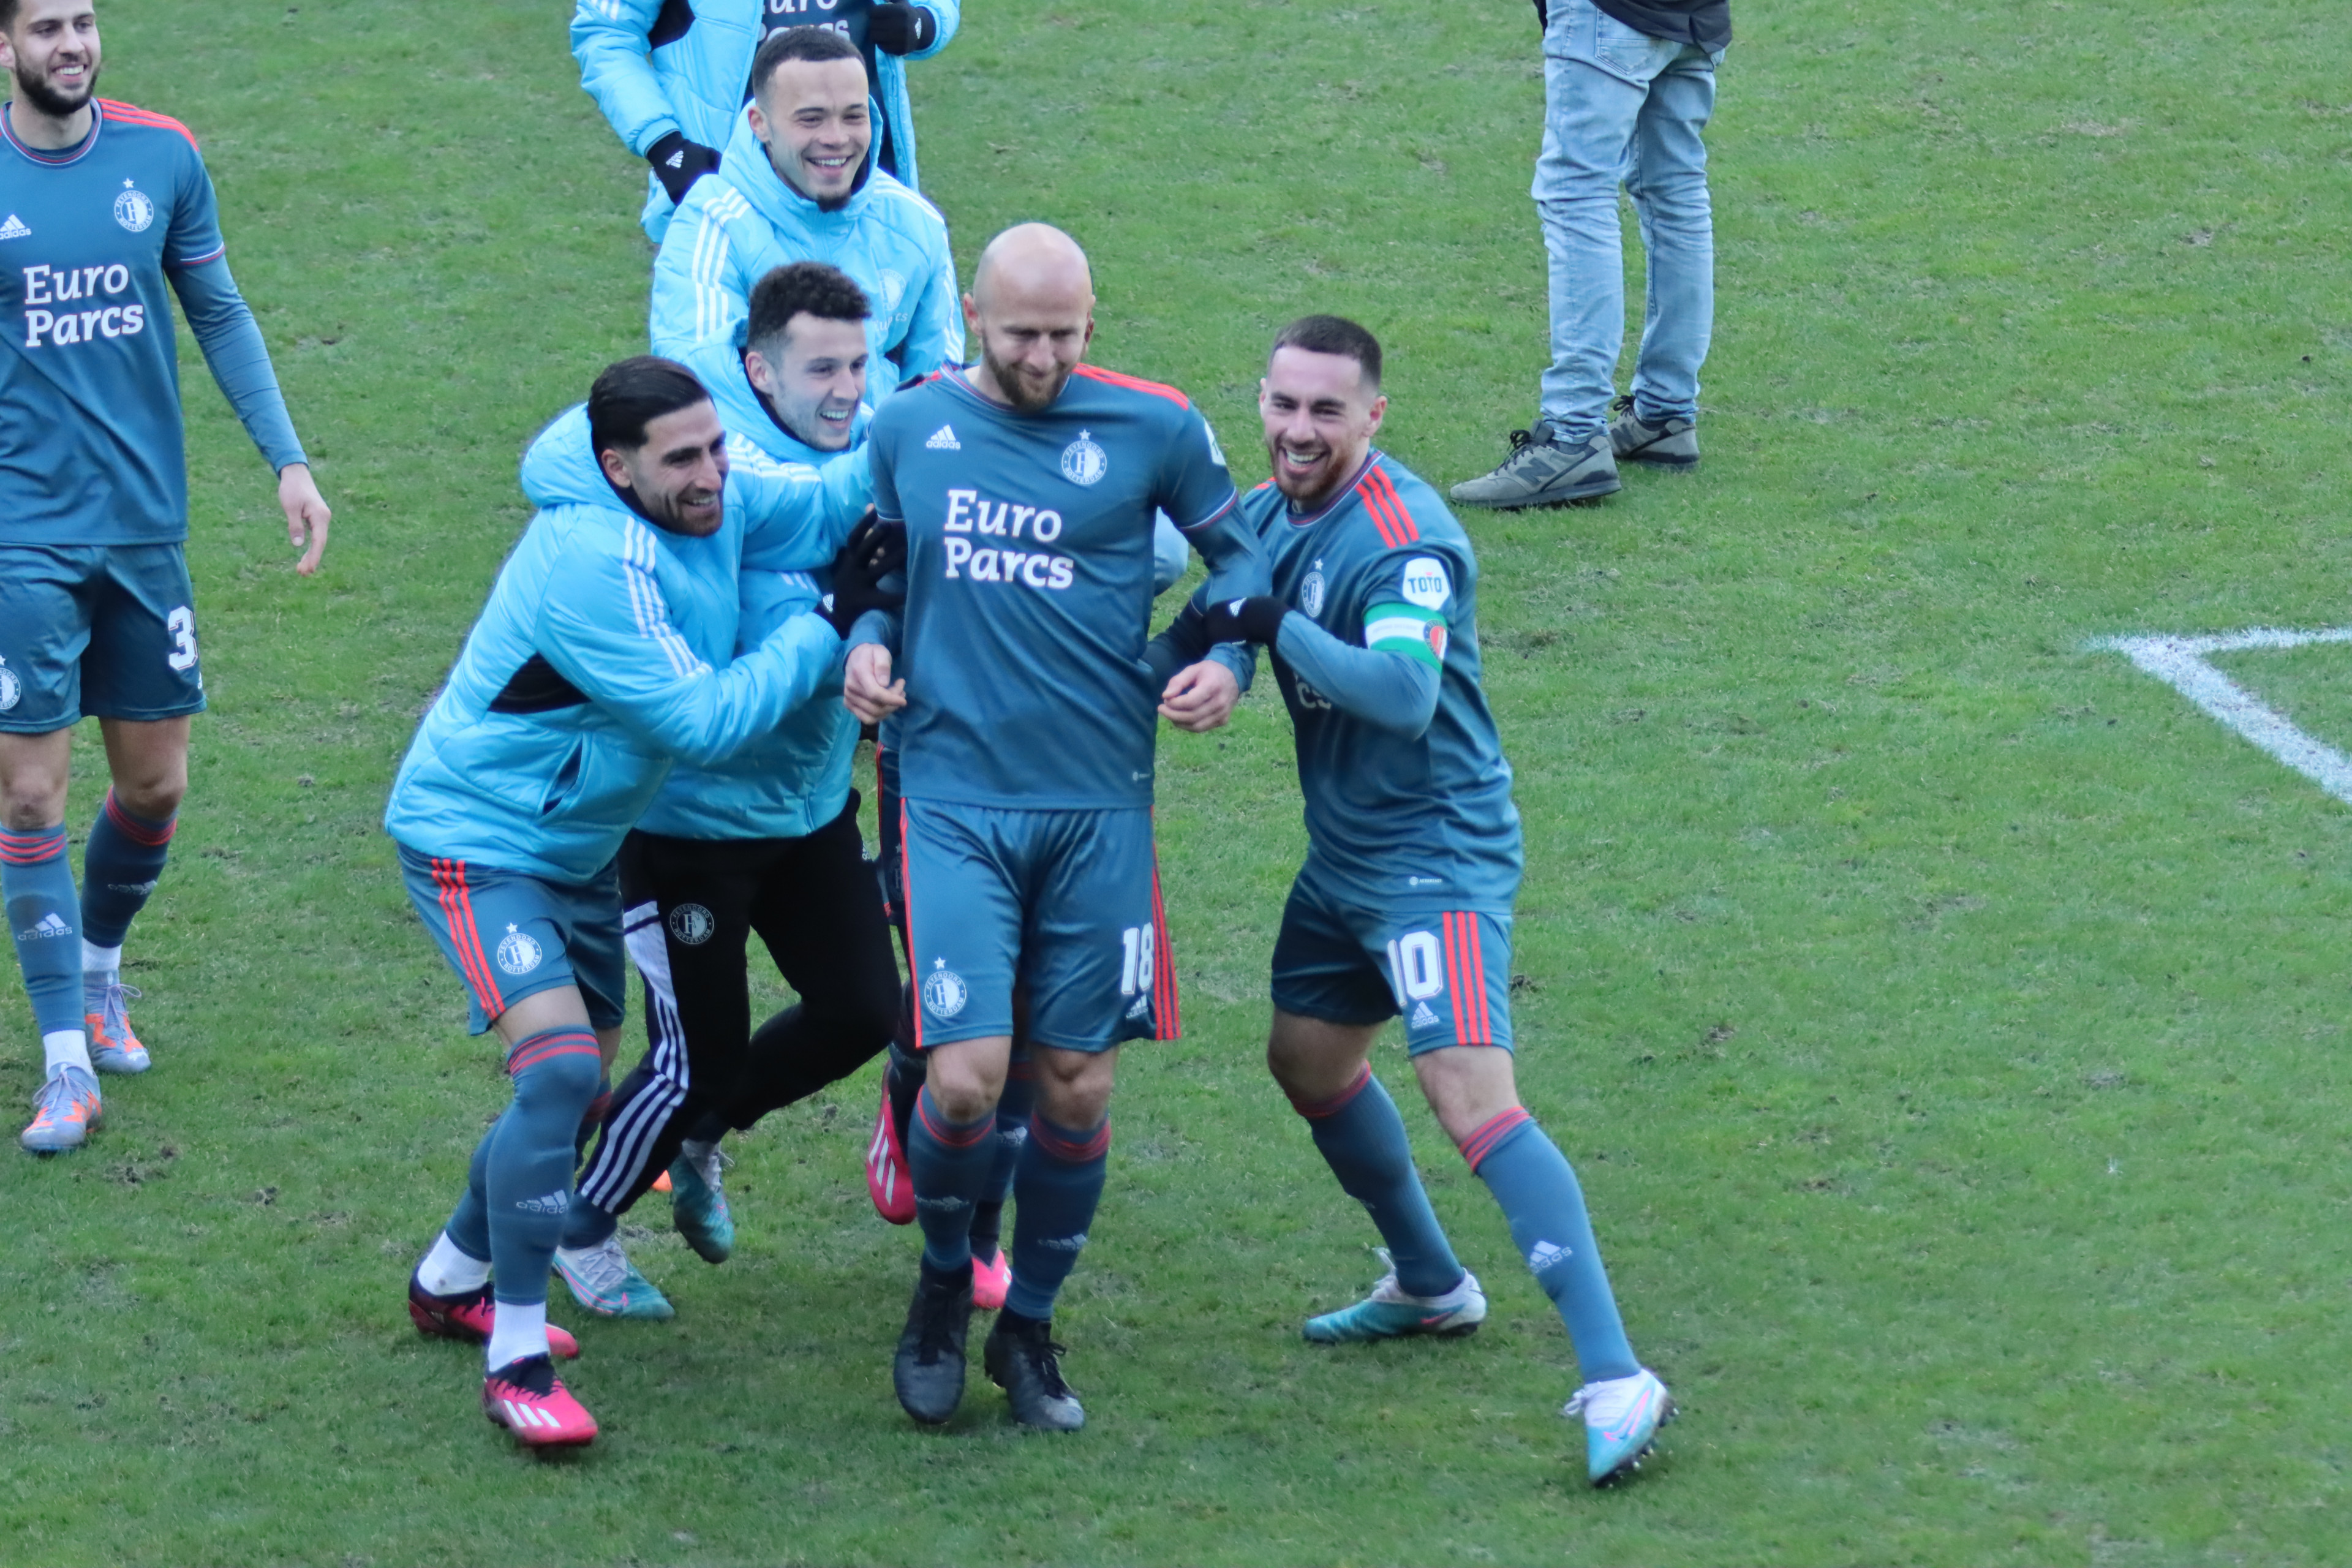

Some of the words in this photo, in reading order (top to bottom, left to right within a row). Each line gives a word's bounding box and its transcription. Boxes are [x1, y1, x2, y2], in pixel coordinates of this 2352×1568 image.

[23, 264, 129, 304] Euro
[25, 305, 144, 347] Parcs
[926, 440, 960, 450] adidas
[1066, 442, 1104, 459] FEYENOORD
[1065, 467, 1103, 483] ROTTERDAM
[944, 489, 1062, 543] Euro
[944, 537, 1074, 589] Parcs
[1408, 576, 1442, 594] TOTO
[168, 606, 198, 670] 3
[18, 926, 73, 941] adidas
[674, 928, 711, 943] ROTTERDAM
[499, 934, 536, 954] FEYENOORD
[503, 954, 540, 973] ROTTERDAM
[1121, 922, 1154, 994] 18
[1387, 930, 1443, 1006] 10
[926, 972, 962, 990] FEYENOORD
[928, 997, 964, 1015] ROTTERDAM
[1411, 1015, 1439, 1029] adidas
